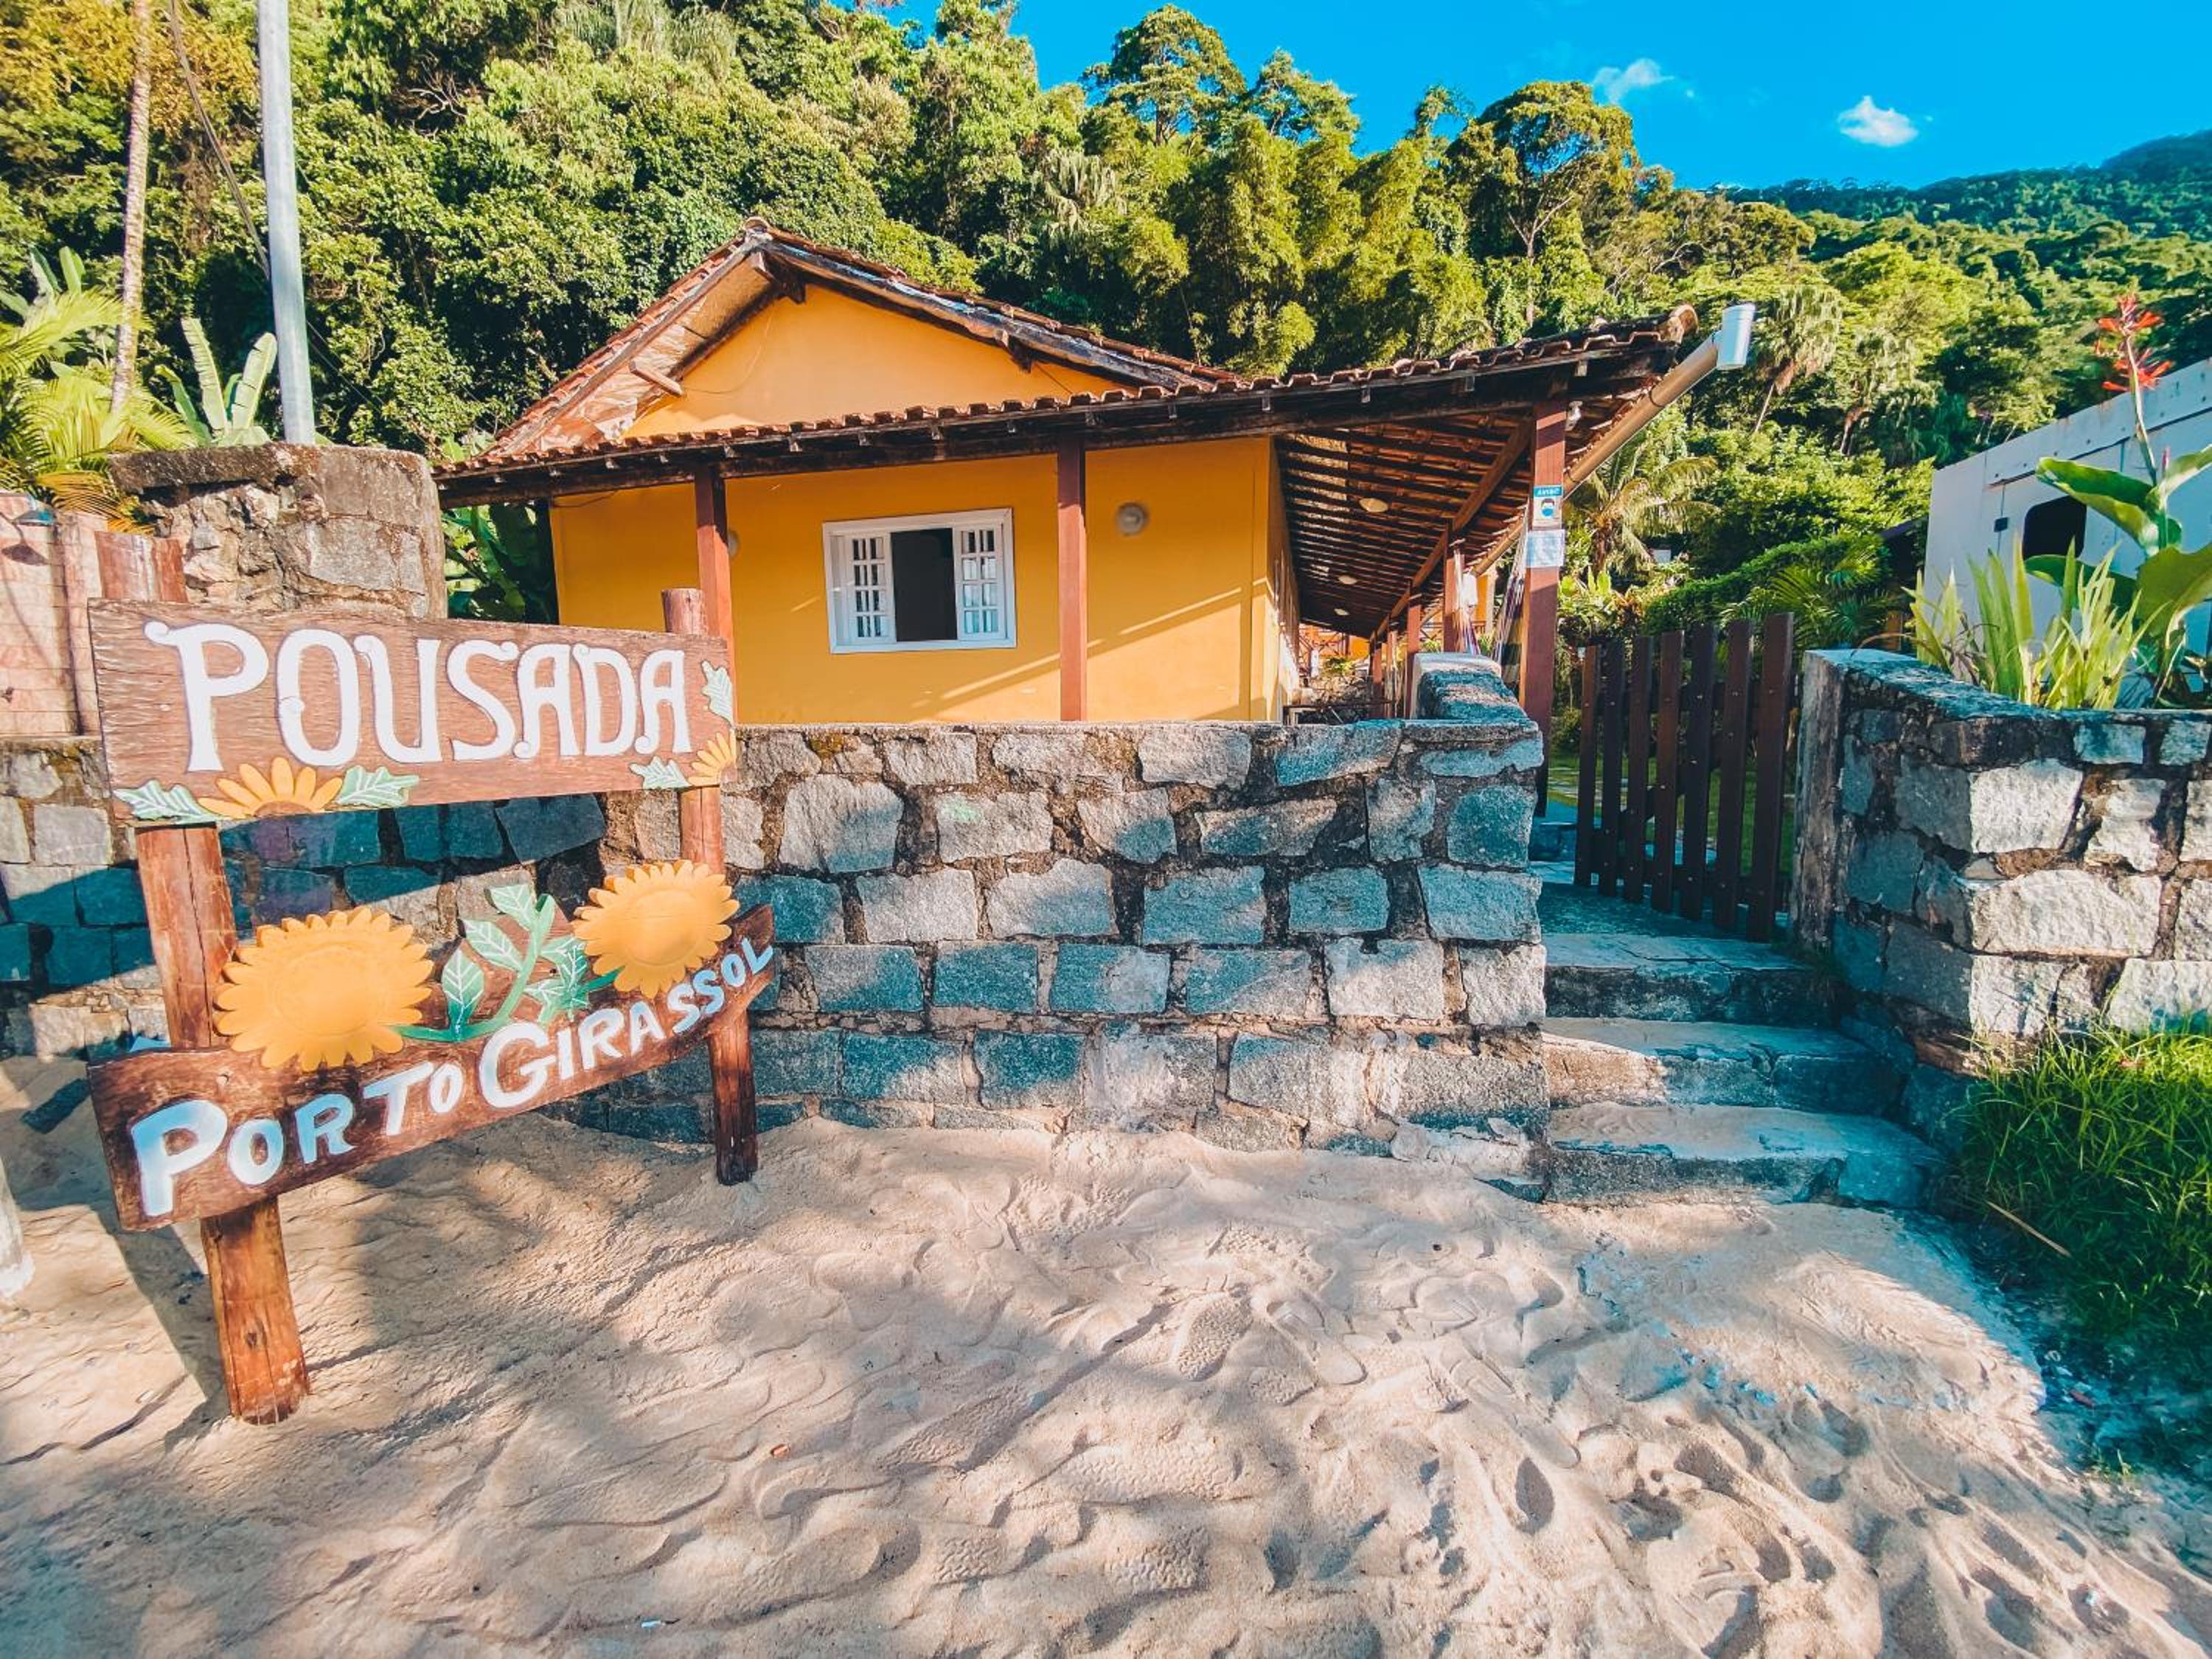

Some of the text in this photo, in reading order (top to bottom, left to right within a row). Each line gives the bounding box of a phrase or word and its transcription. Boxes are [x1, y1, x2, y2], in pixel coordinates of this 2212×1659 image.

[144, 620, 693, 773] POUSADA
[129, 936, 774, 1217] PORTO GIRASSOL
